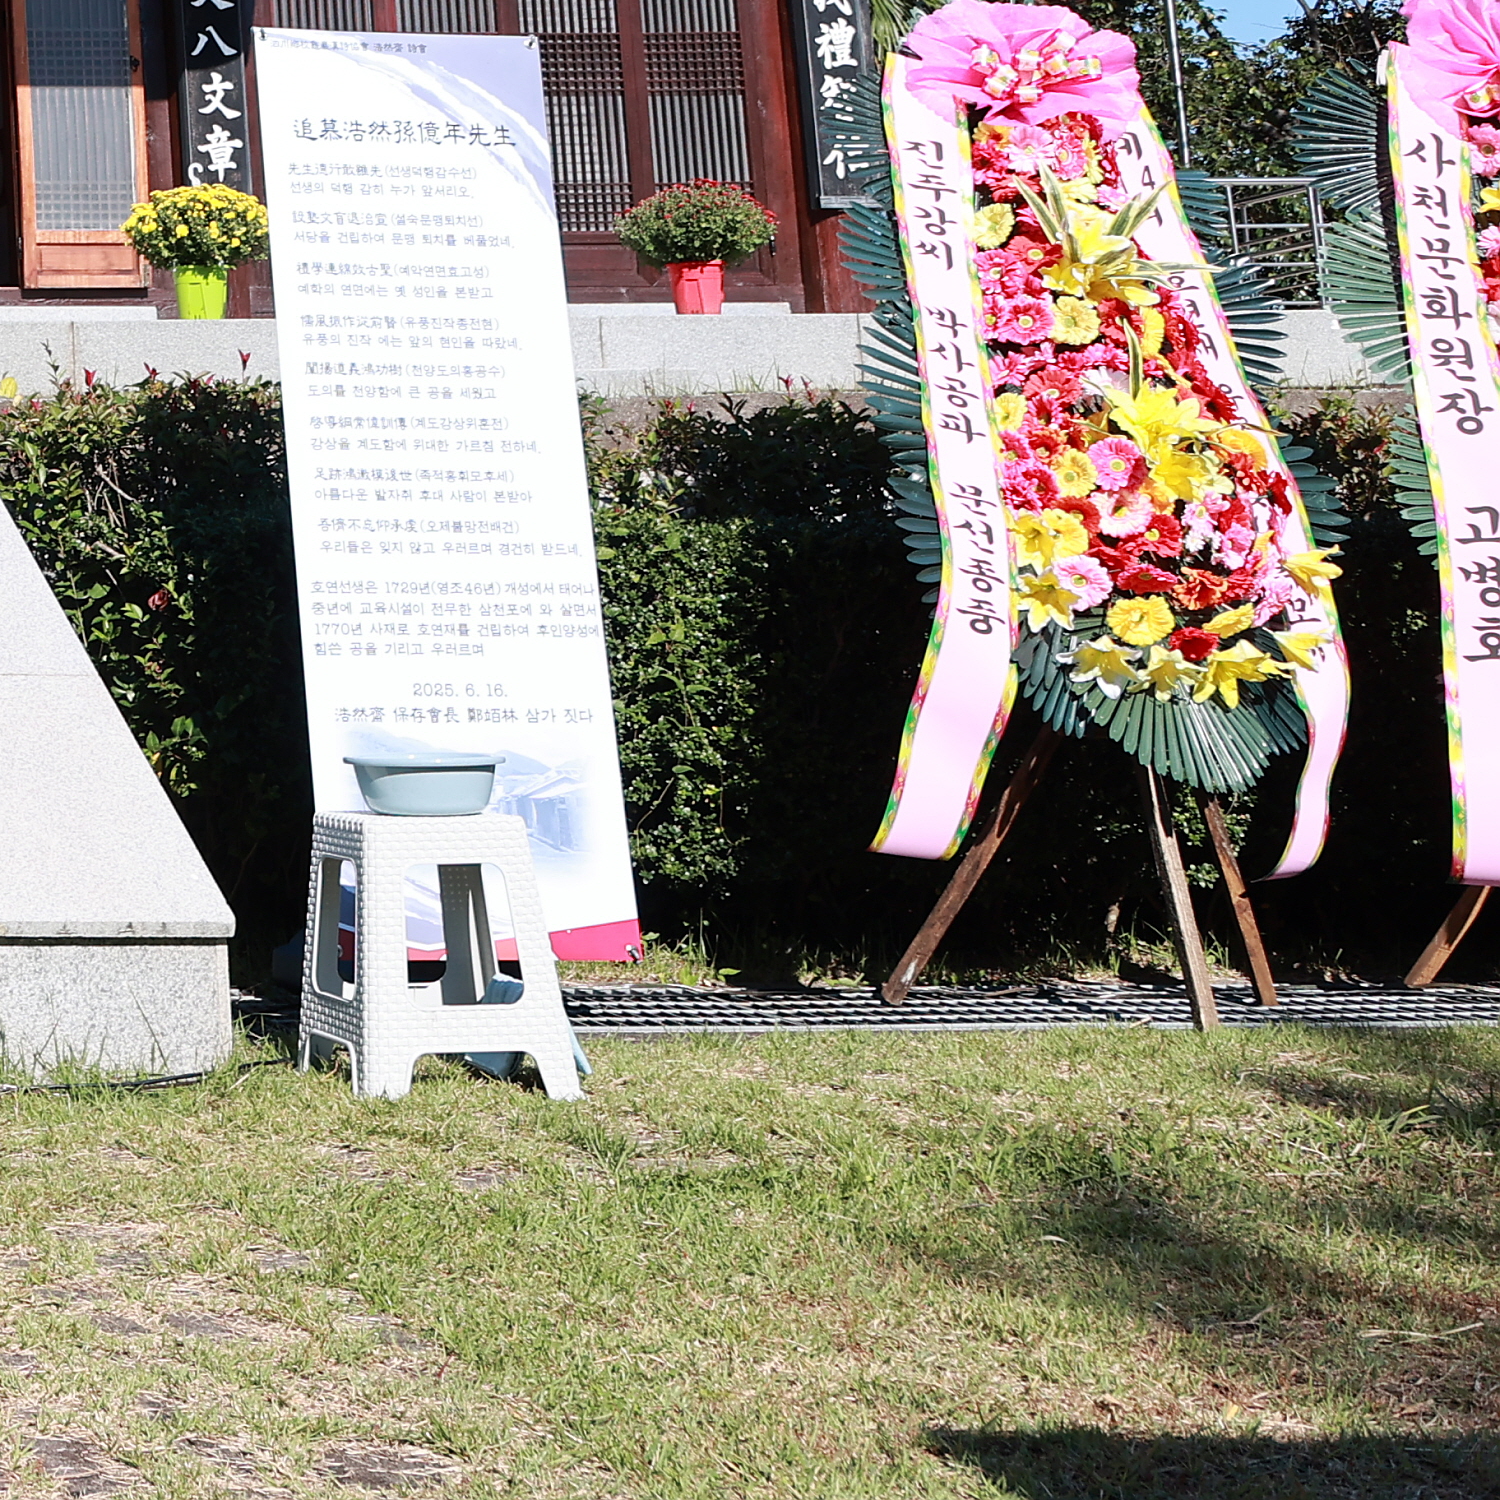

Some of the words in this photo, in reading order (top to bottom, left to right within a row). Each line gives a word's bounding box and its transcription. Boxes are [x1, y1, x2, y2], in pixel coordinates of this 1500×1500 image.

[293, 117, 517, 147] 追慕浩然孫億年先生
[903, 140, 957, 271] 진주강씨
[1404, 133, 1494, 436] 사천문화원장
[922, 305, 986, 444] 박사공파
